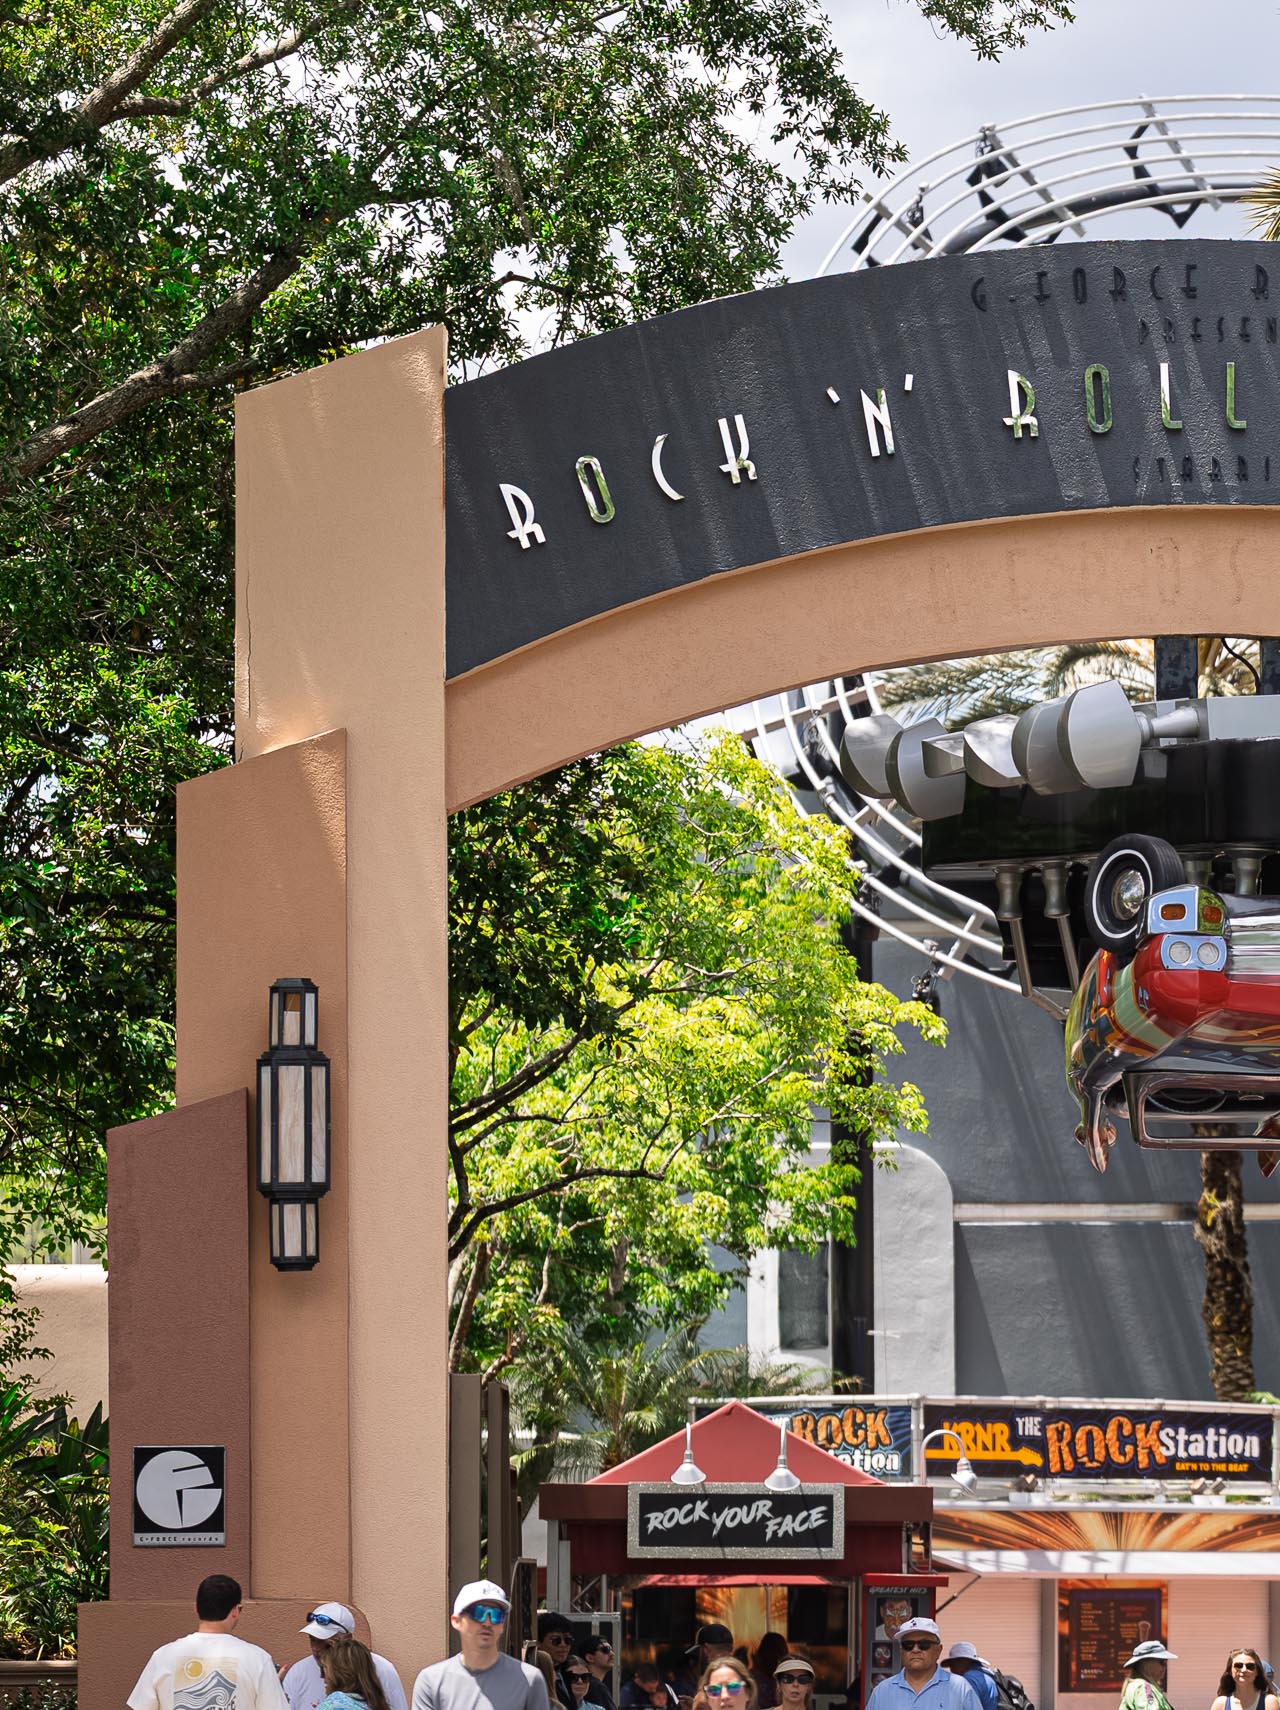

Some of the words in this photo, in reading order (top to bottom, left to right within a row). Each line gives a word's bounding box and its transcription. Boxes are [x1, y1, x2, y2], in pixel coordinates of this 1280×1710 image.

[970, 264, 1198, 312] G-FORCE
[499, 414, 758, 550] ROCK
[792, 1407, 891, 1448] ROCK
[1016, 1416, 1042, 1436] THE
[1046, 1416, 1167, 1474] ROCK
[1159, 1427, 1260, 1459] Station
[1199, 1462, 1210, 1471] TO
[1212, 1463, 1227, 1472] THE
[1228, 1463, 1249, 1472] BEAT
[644, 1500, 710, 1535] ROCK
[712, 1499, 774, 1537] YOUR
[765, 1506, 828, 1542] FACE
